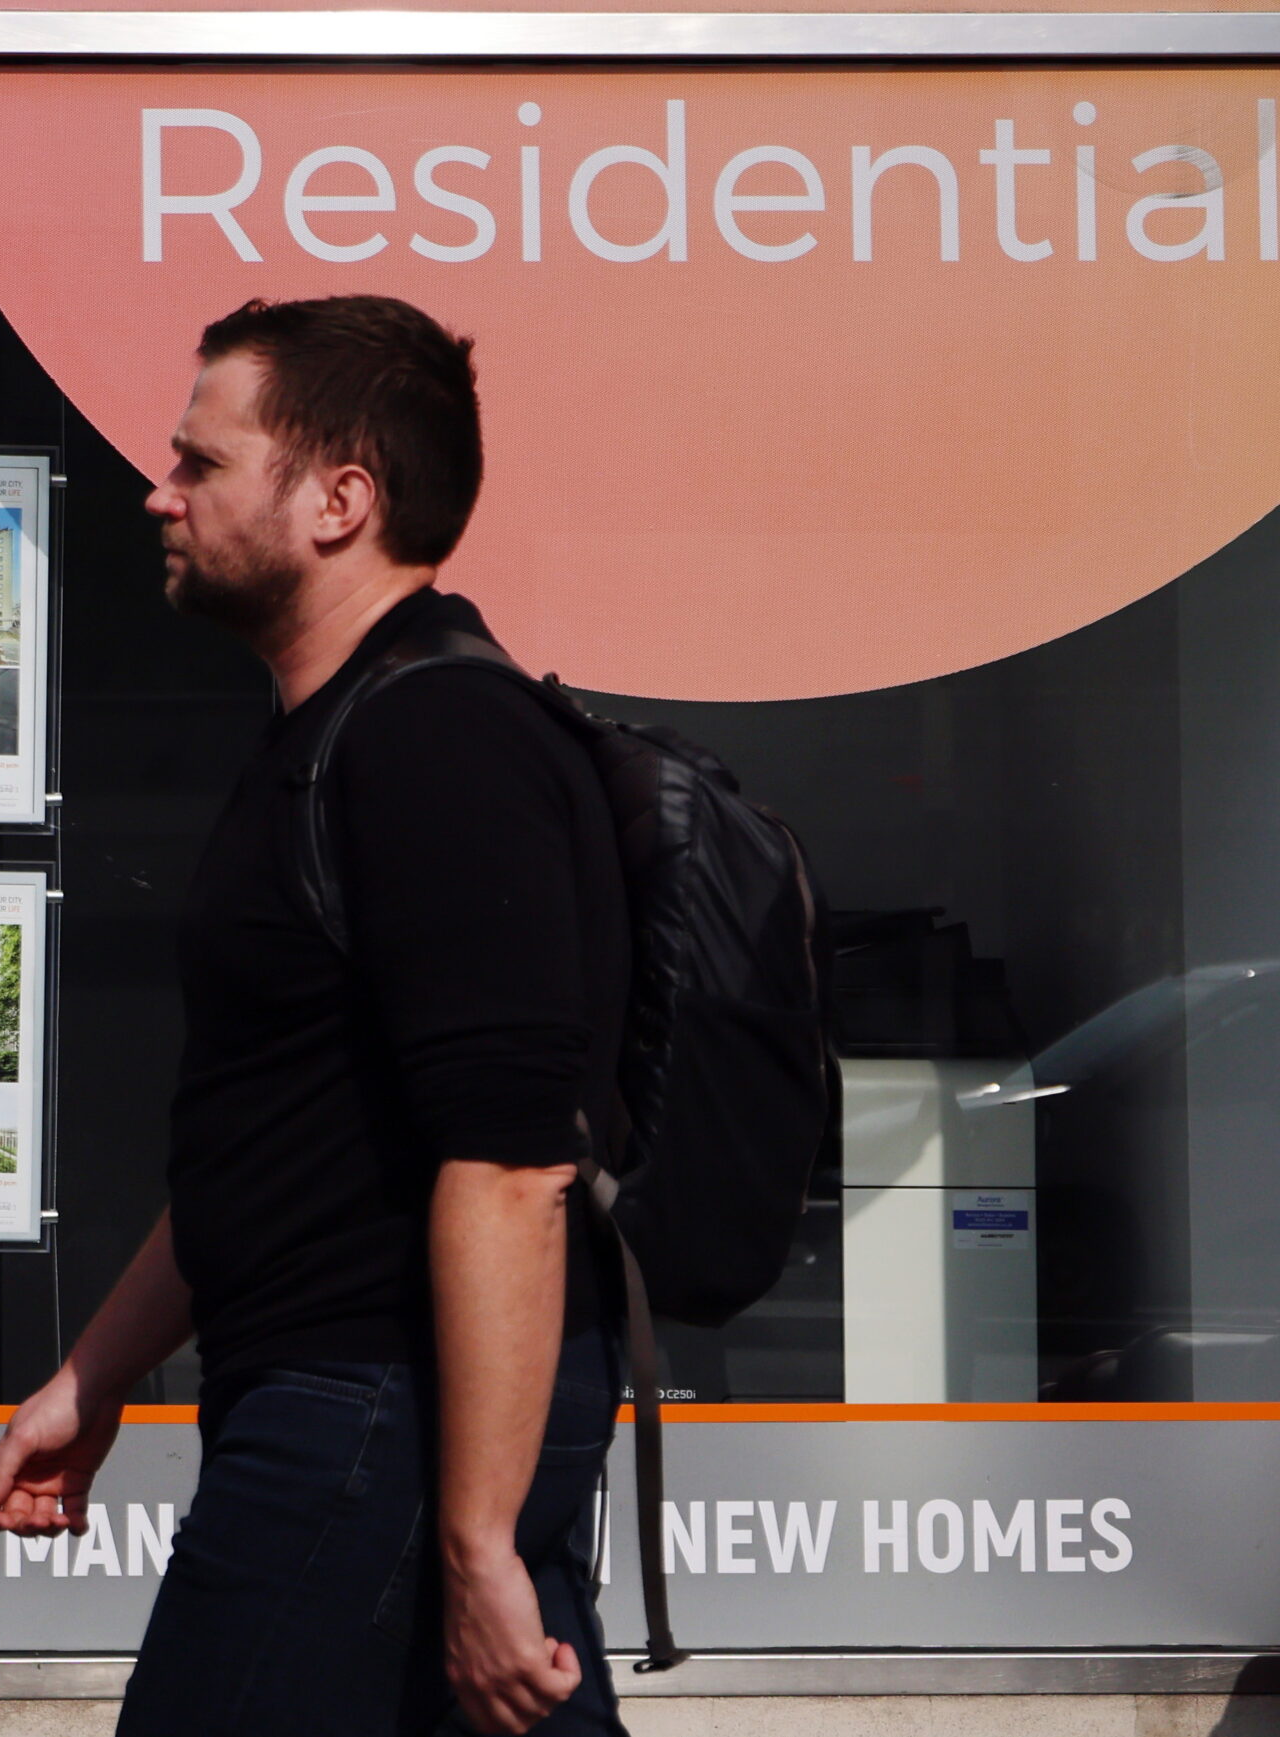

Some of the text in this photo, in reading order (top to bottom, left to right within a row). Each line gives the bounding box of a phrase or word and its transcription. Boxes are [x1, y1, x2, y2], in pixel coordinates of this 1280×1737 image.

[141, 98, 1279, 262] Residential
[666, 1390, 696, 1399] C250i
[662, 1500, 837, 1574] NEW
[864, 1497, 1133, 1574] HOMES
